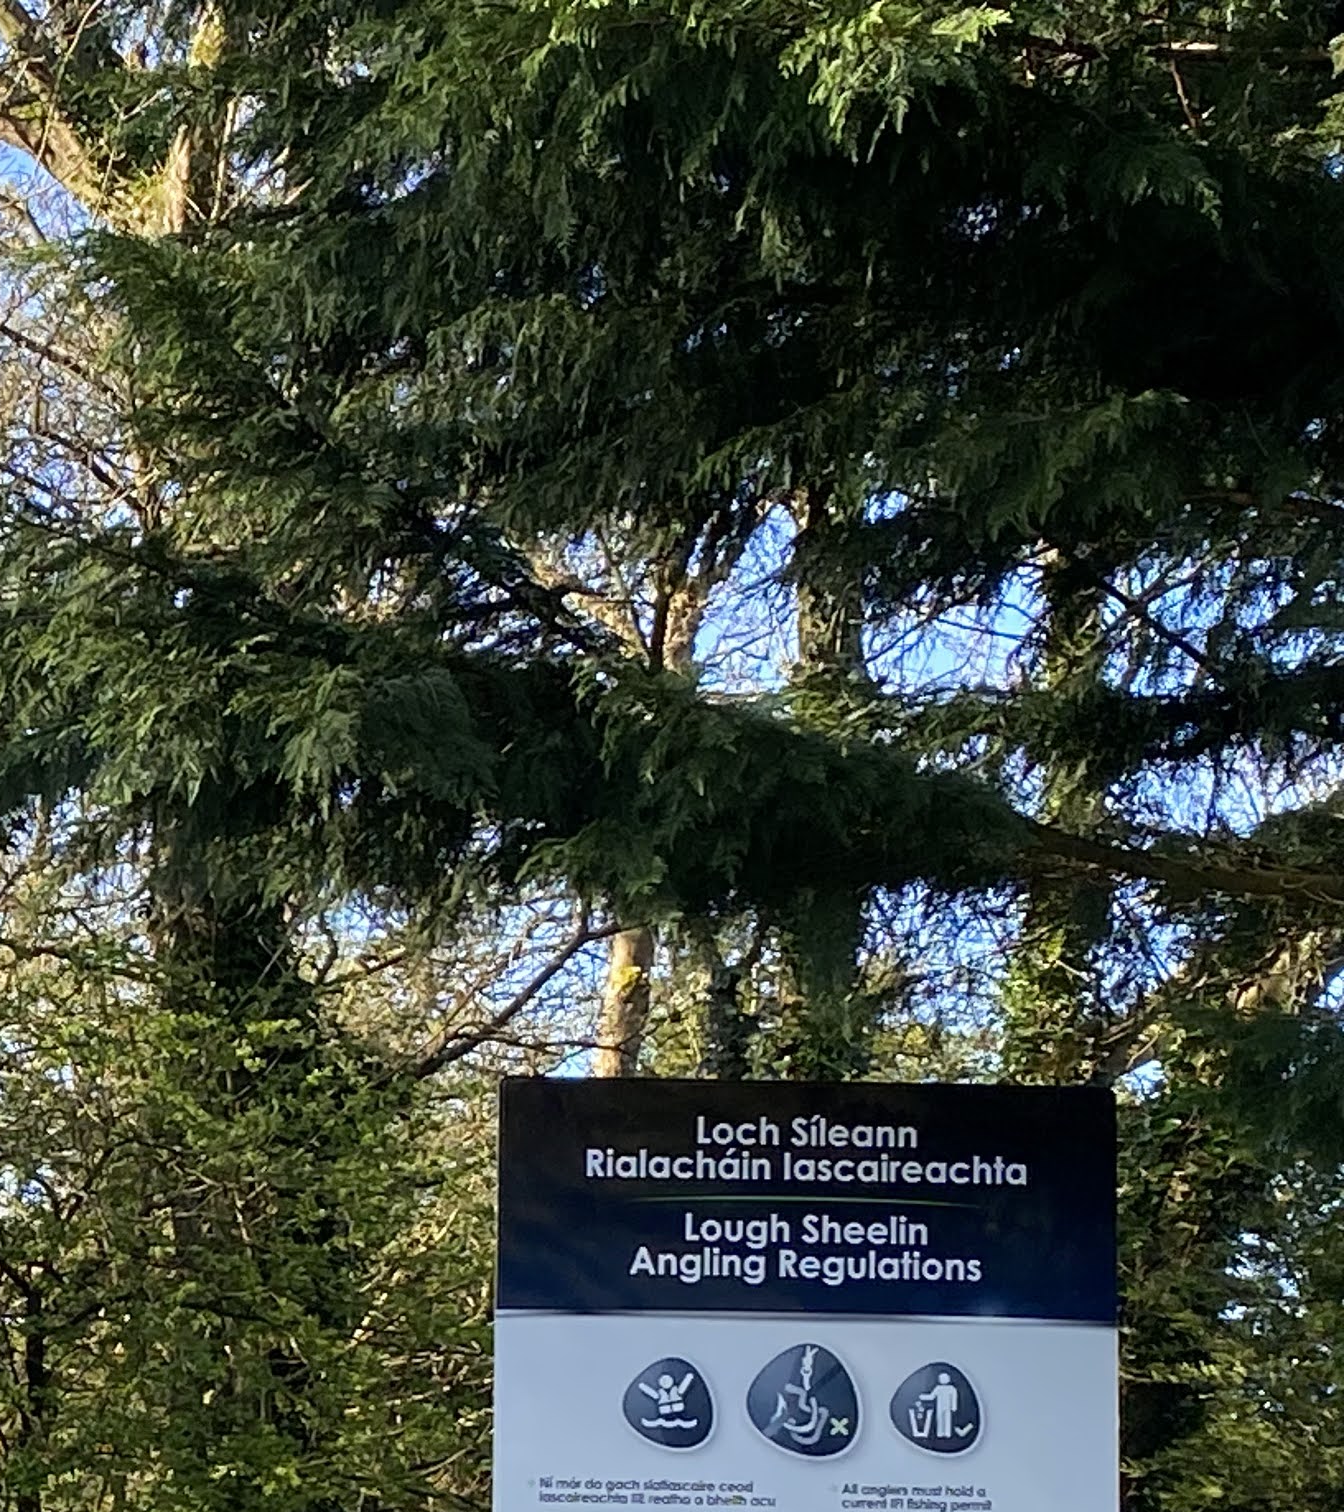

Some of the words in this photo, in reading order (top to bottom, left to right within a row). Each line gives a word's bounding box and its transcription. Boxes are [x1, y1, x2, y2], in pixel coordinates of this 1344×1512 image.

[697, 1116, 780, 1147] Loch
[791, 1116, 918, 1147] Síleann
[586, 1148, 771, 1179] Rialacháin
[784, 1153, 1027, 1184] Iascaireachta
[685, 1213, 790, 1246] Lough
[801, 1215, 928, 1245] Sheelin
[630, 1246, 766, 1286] Angling
[779, 1250, 982, 1286] Regulations
[841, 1483, 858, 1494] All
[861, 1486, 908, 1498] anglers
[911, 1486, 943, 1496] must
[945, 1485, 974, 1497] hold
[841, 1499, 888, 1509] current
[890, 1498, 904, 1509] IFI
[907, 1499, 948, 1512] fishing
[950, 1500, 992, 1512] permit
